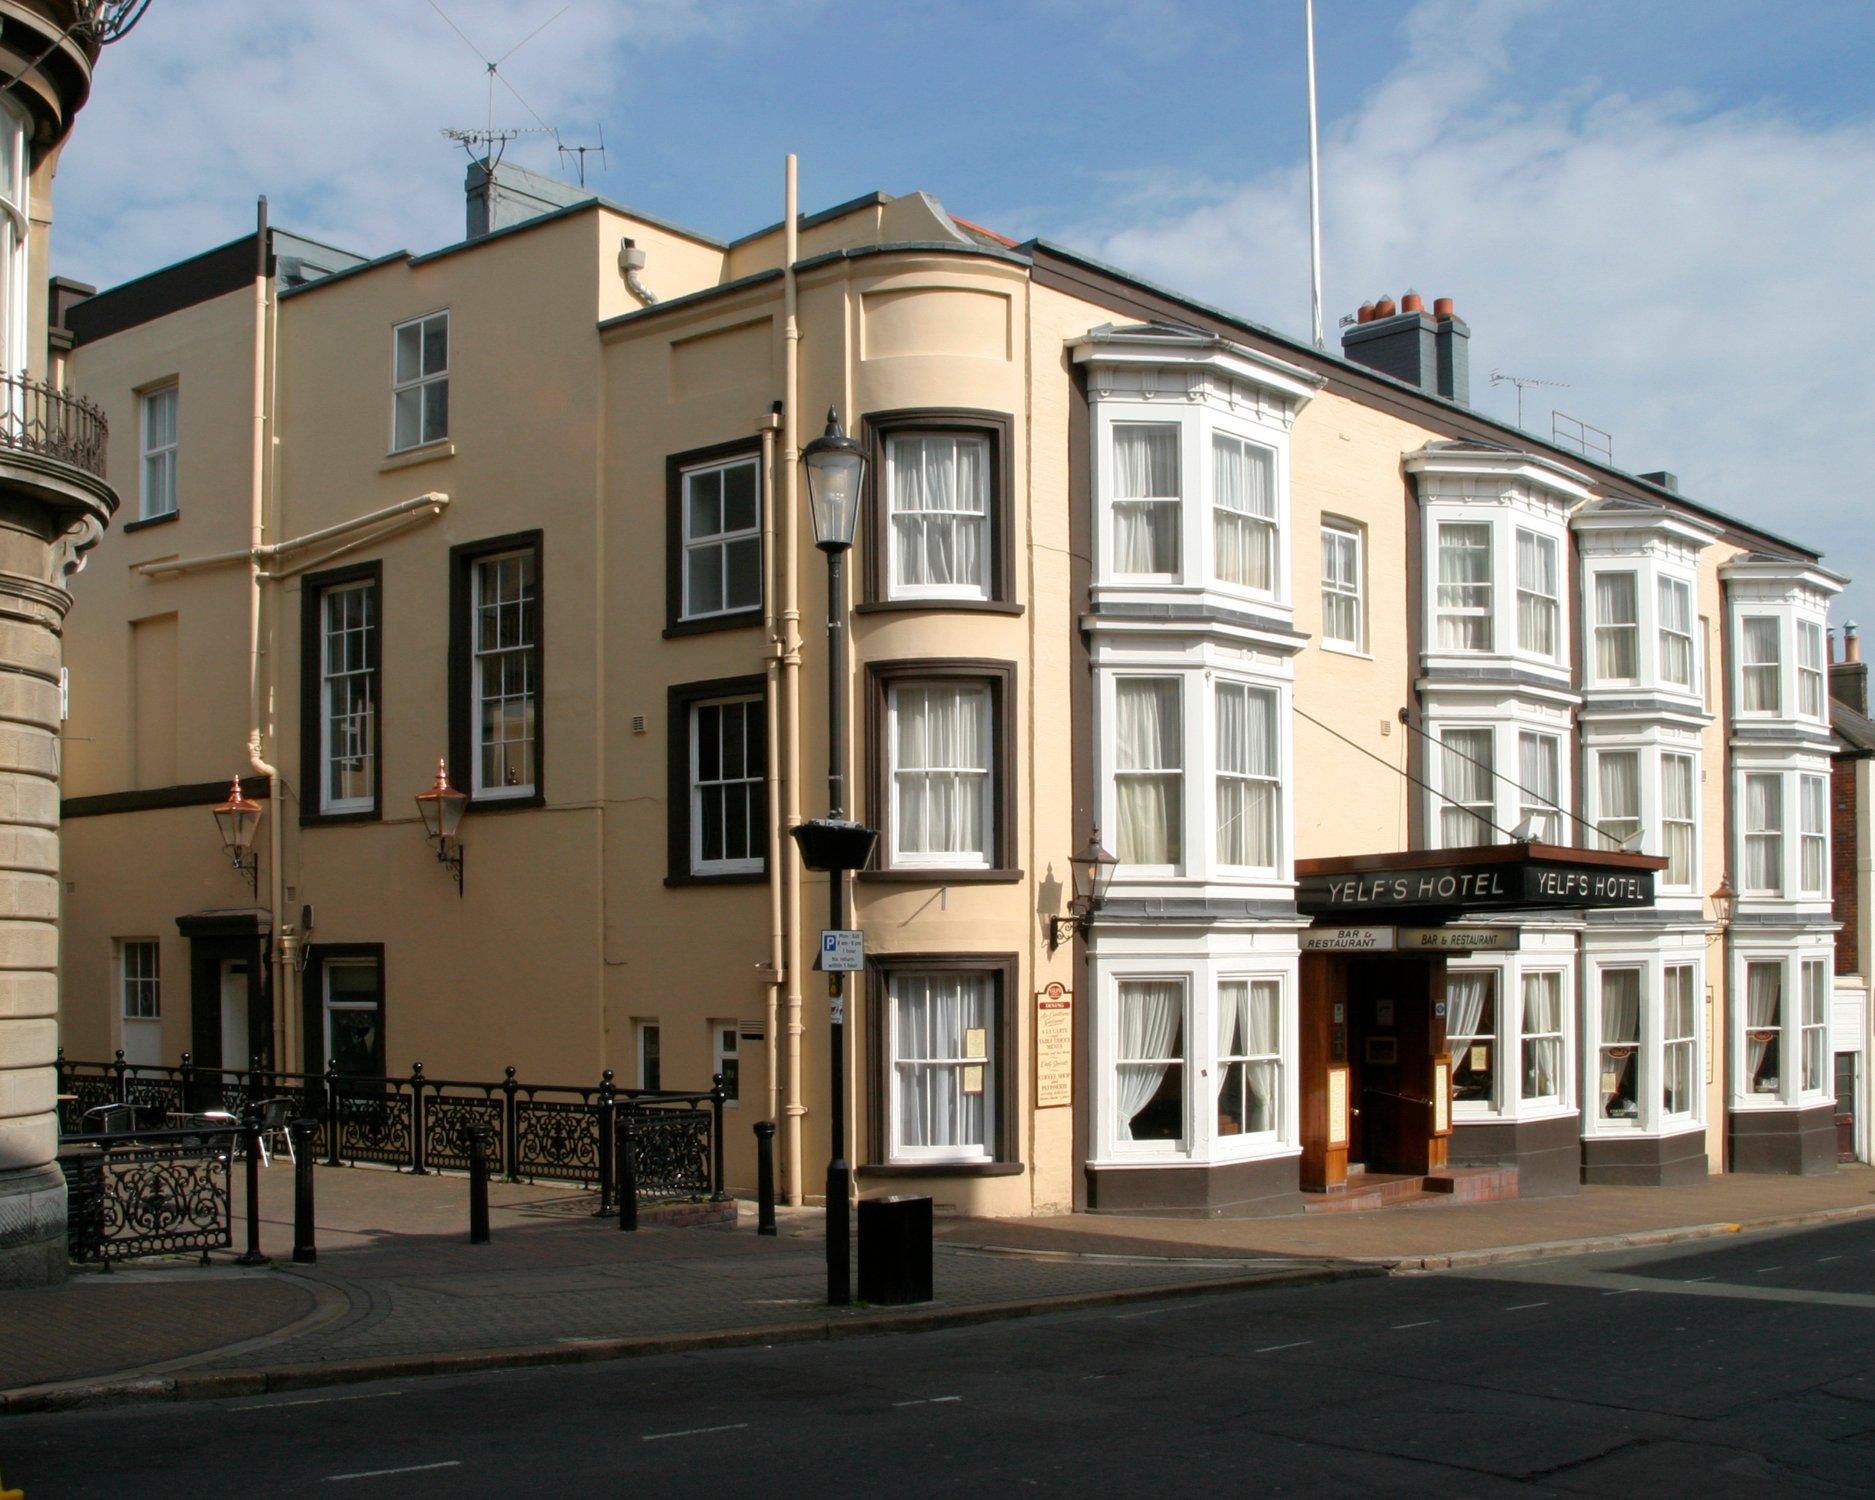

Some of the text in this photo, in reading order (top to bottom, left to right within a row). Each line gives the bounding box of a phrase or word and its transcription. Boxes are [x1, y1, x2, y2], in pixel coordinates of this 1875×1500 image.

[1329, 873, 1504, 903] YELF'S HOTEL
[1537, 873, 1644, 899] YELF'S HOTEL
[1337, 930, 1360, 939] BAR
[1421, 934, 1438, 945] BAR
[1450, 935, 1498, 946] RESTAURANT
[827, 937, 835, 950] P
[1307, 939, 1377, 948] RESTAURANT
